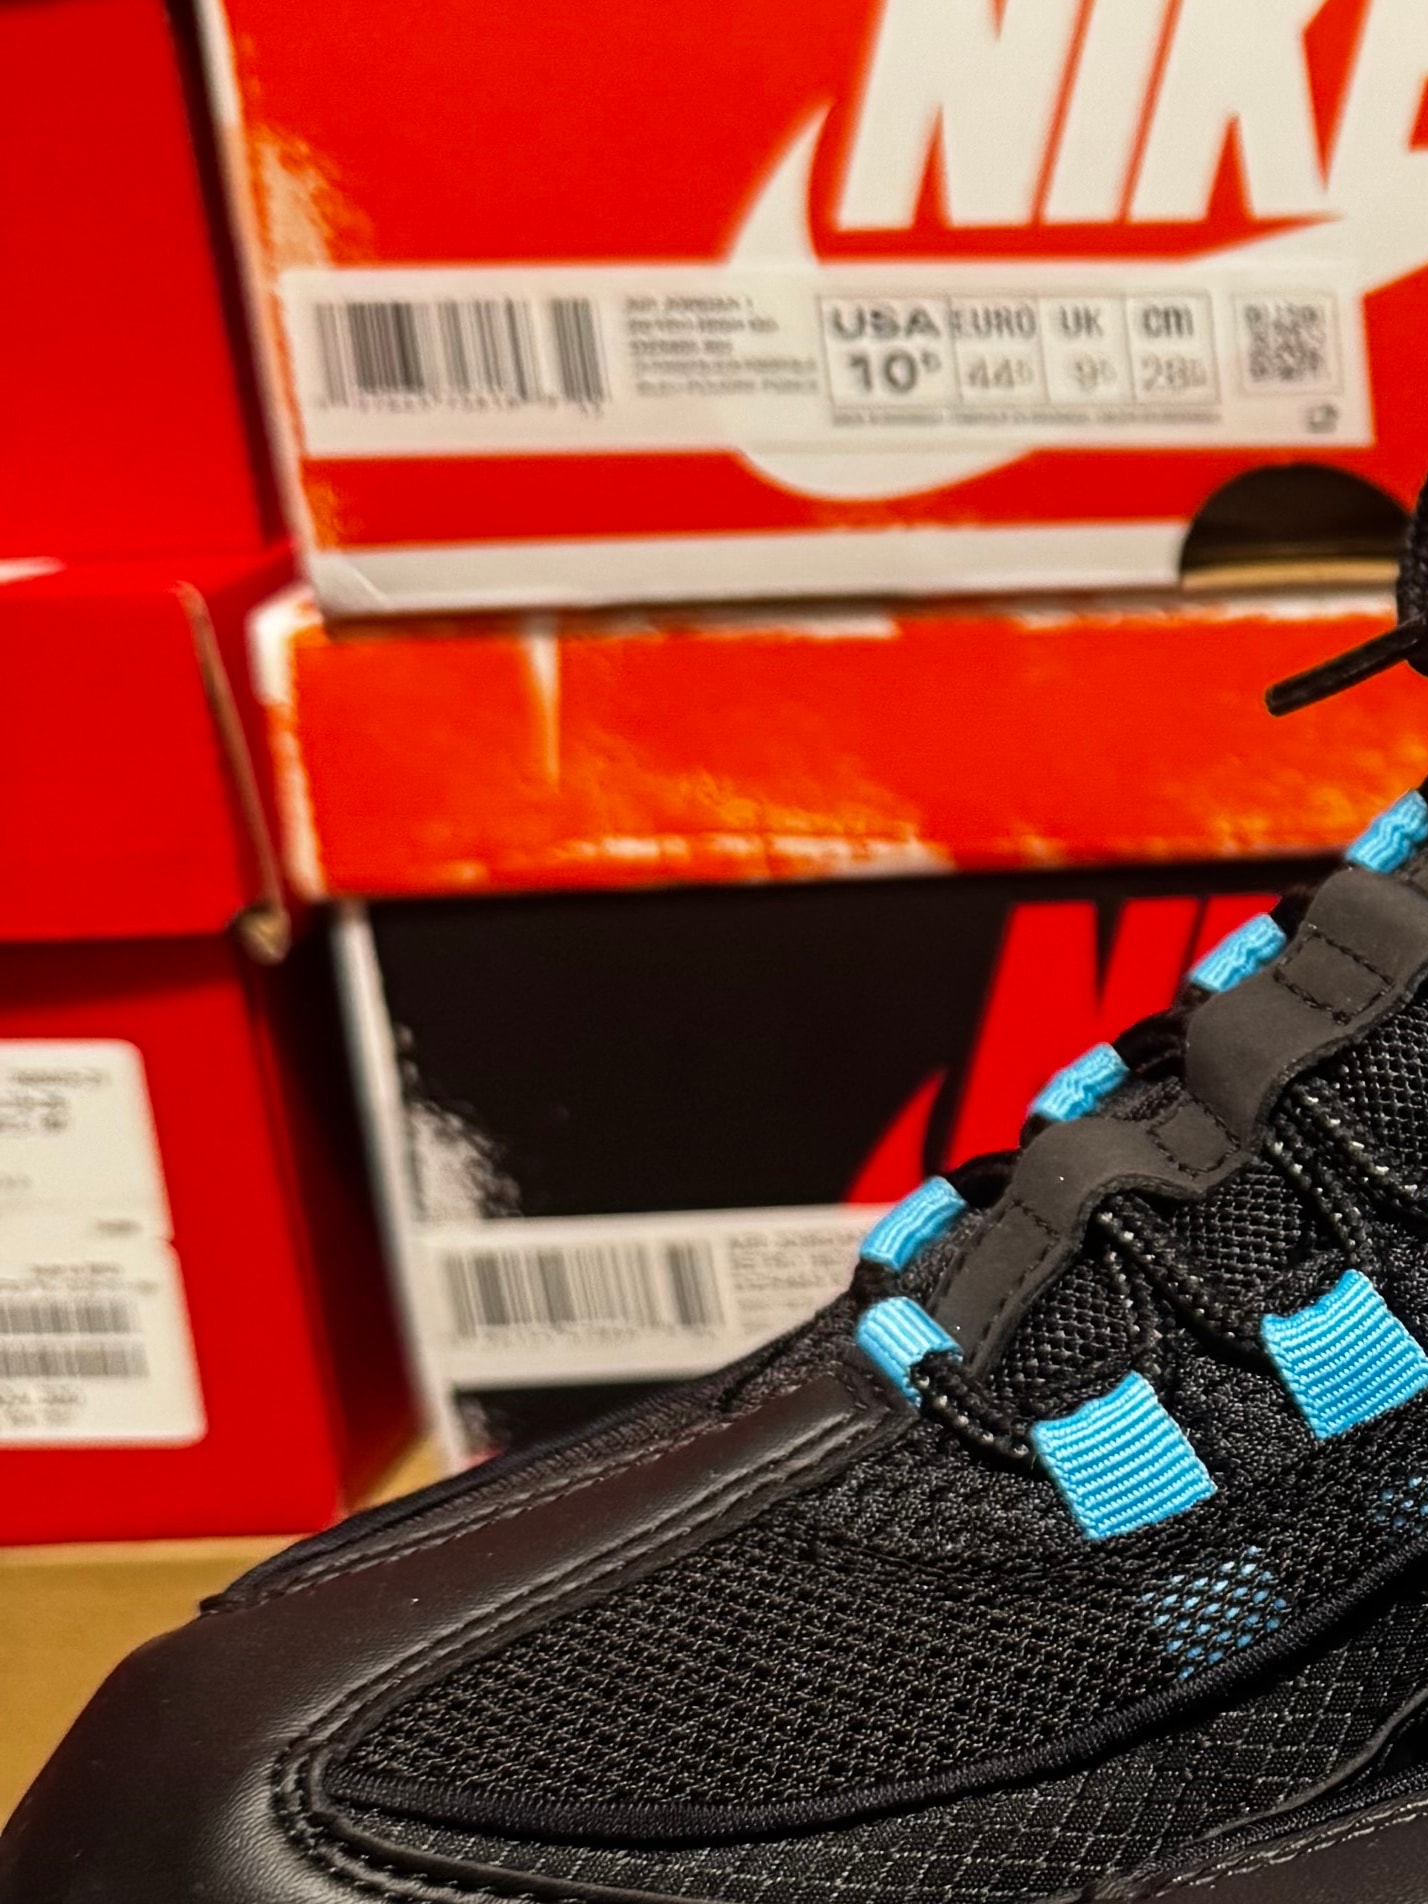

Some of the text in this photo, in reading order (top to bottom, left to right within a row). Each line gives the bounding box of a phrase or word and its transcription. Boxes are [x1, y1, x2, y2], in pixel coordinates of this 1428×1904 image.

[832, 303, 1194, 341] USA EURO UK cm
